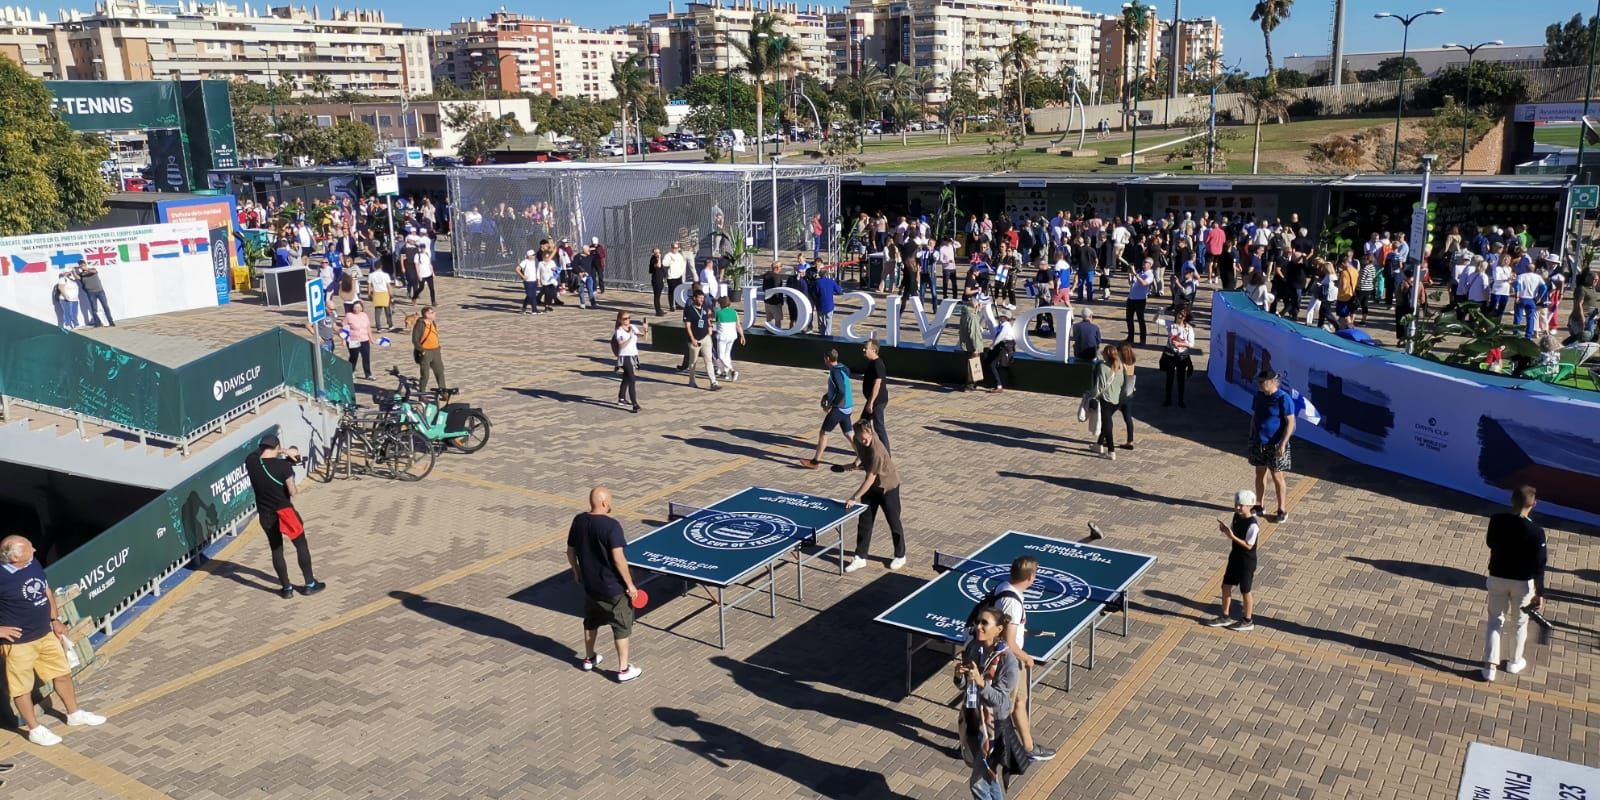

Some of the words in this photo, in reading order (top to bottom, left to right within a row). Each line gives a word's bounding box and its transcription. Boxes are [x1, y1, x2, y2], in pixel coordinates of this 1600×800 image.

[62, 96, 134, 115] TENNIS
[310, 284, 322, 318] P
[223, 372, 246, 393] DAVIS
[245, 365, 261, 382] CUP
[210, 477, 226, 497] THE
[221, 488, 232, 505] OF
[1023, 544, 1046, 552] CUP
[1044, 543, 1083, 555] TENNIS
[1047, 548, 1088, 561] WORLD
[1084, 551, 1102, 559] OF
[642, 551, 664, 559] THE
[662, 555, 698, 566] WORLD
[696, 562, 719, 570] CUP
[662, 560, 699, 571] TENNIS
[1089, 555, 1112, 564] THE
[74, 564, 105, 592] AVIS
[106, 547, 128, 573] CUP
[1053, 573, 1083, 591] FINALS
[1041, 594, 1082, 610] TENNIS
[926, 612, 951, 624] THE
[935, 621, 954, 629] OF
